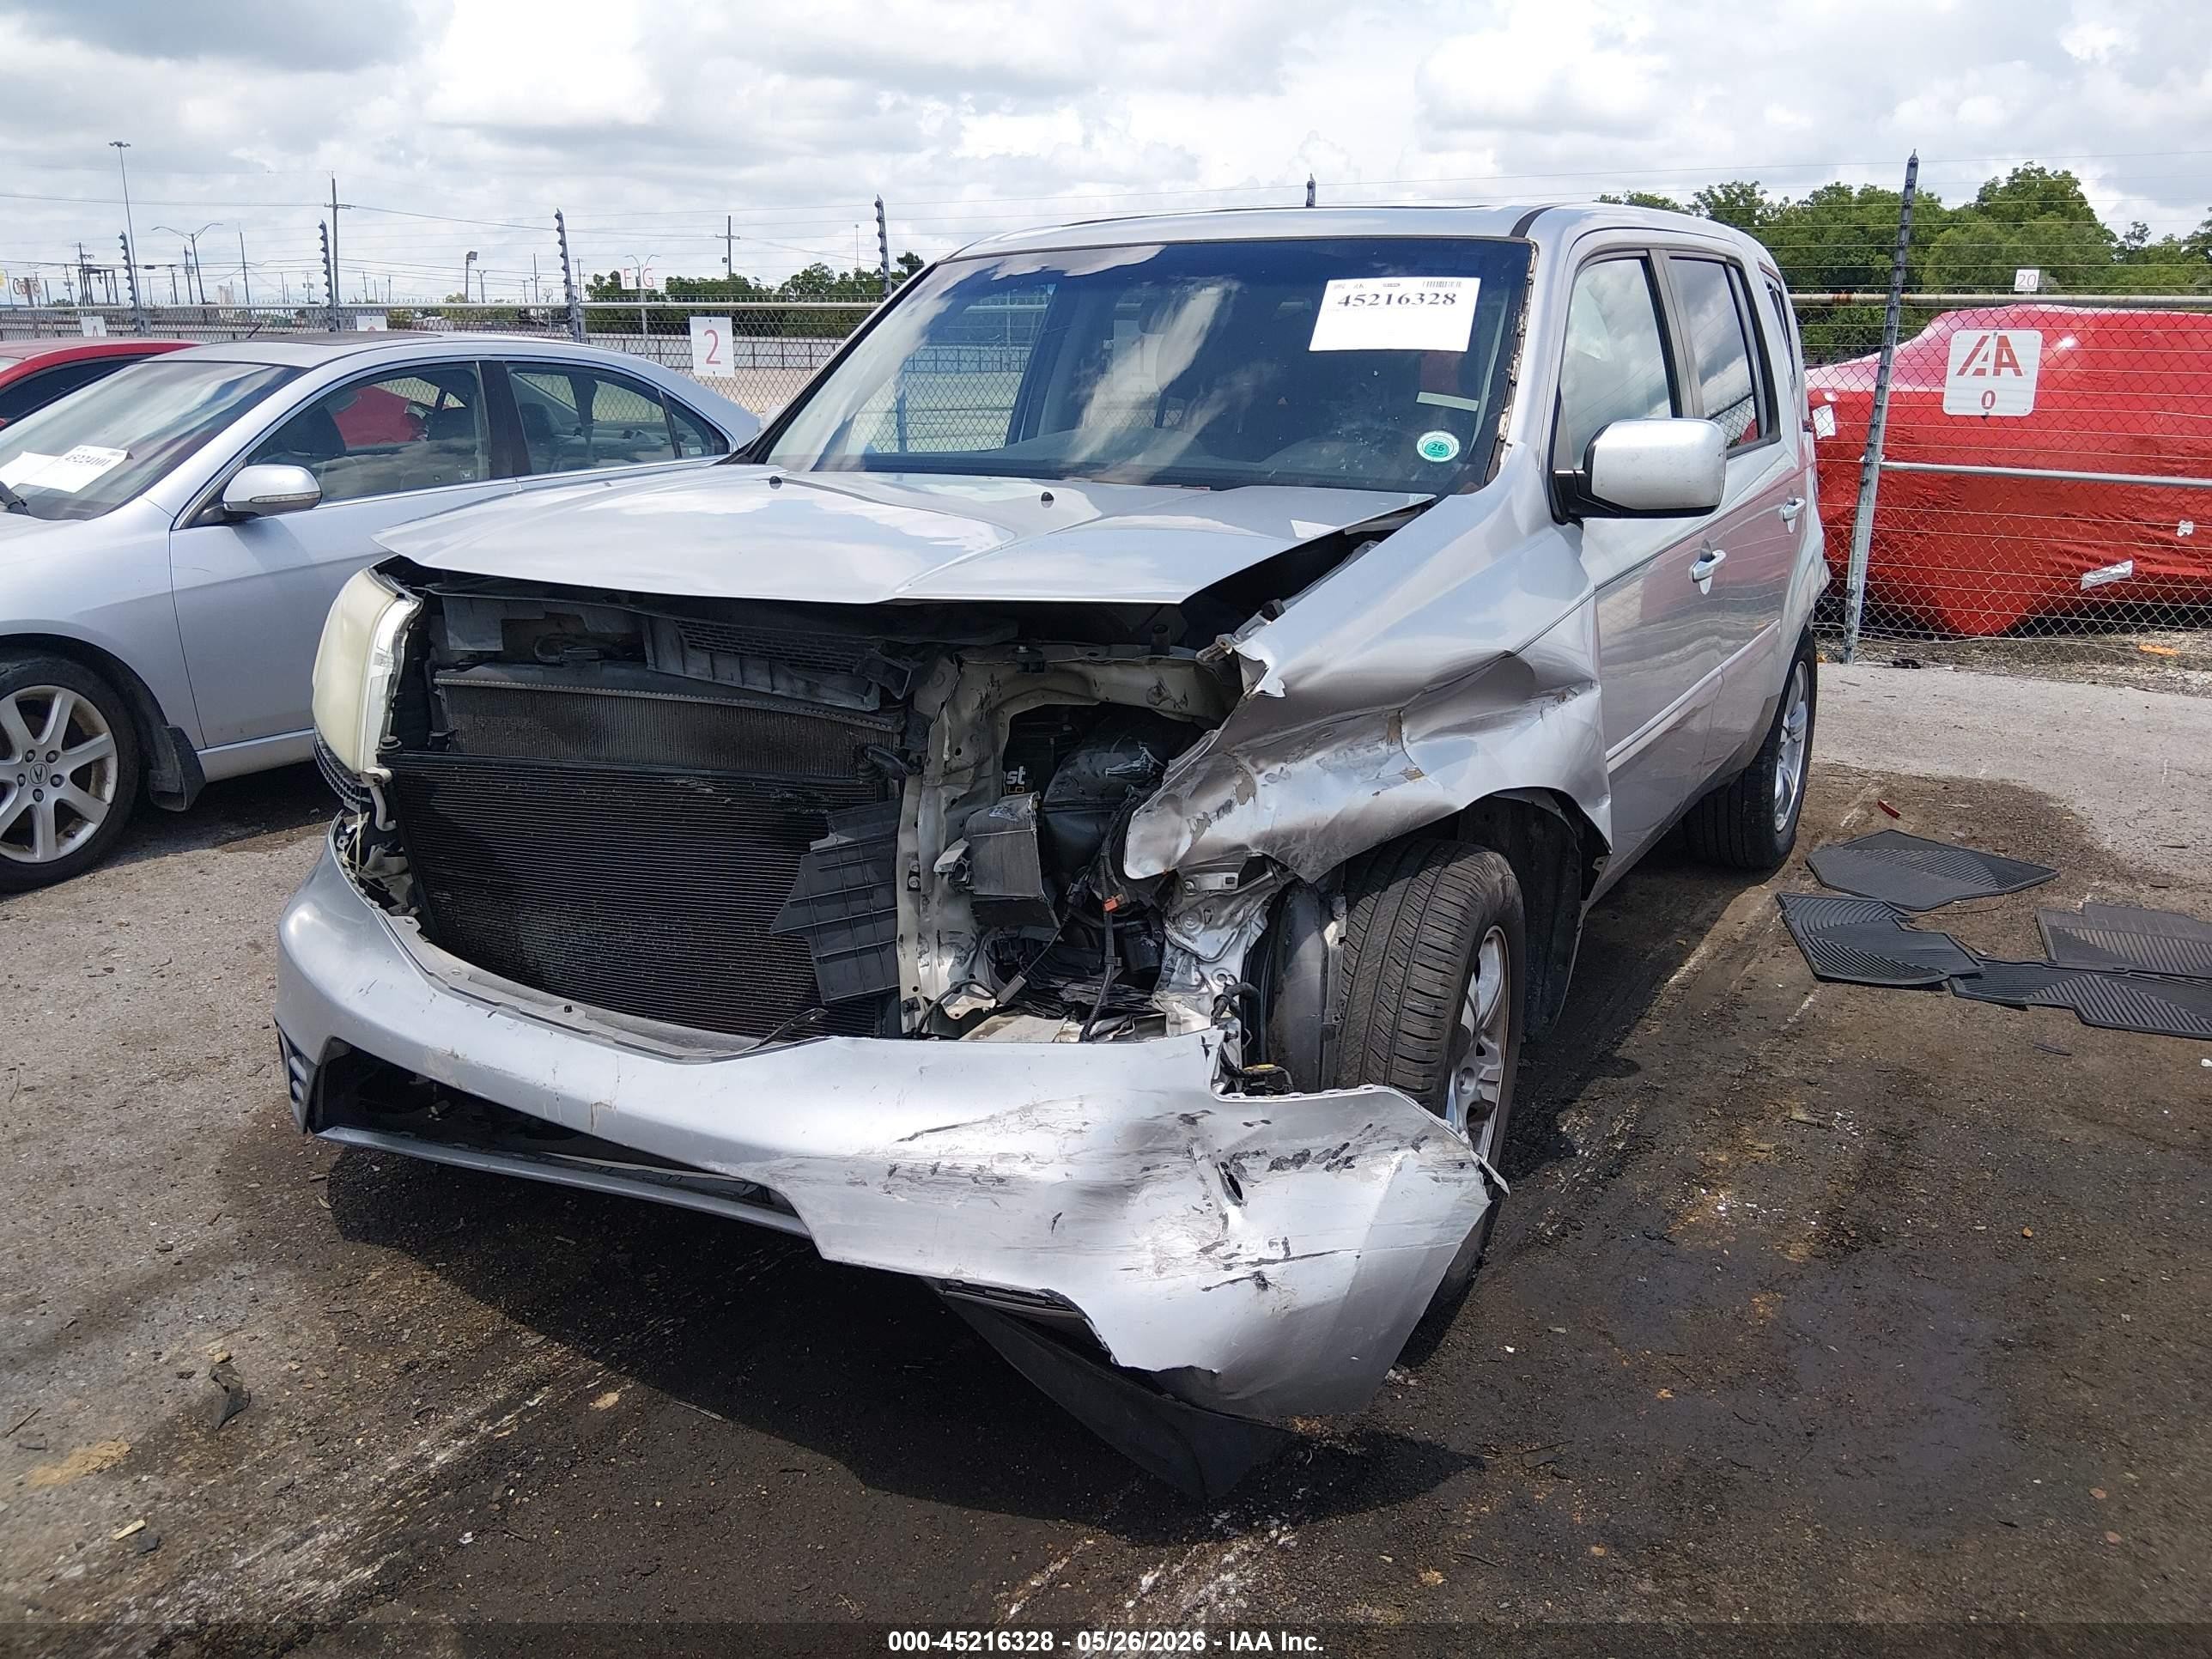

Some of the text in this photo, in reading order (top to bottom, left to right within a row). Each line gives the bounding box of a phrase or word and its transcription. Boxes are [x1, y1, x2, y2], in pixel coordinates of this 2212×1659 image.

[623, 268, 631, 288] F
[642, 267, 654, 288] G
[2018, 274, 2037, 288] 20
[1338, 292, 1457, 307] 45216328
[704, 329, 721, 365] 2
[1981, 390, 1996, 410] 0
[1430, 443, 1444, 452] 26
